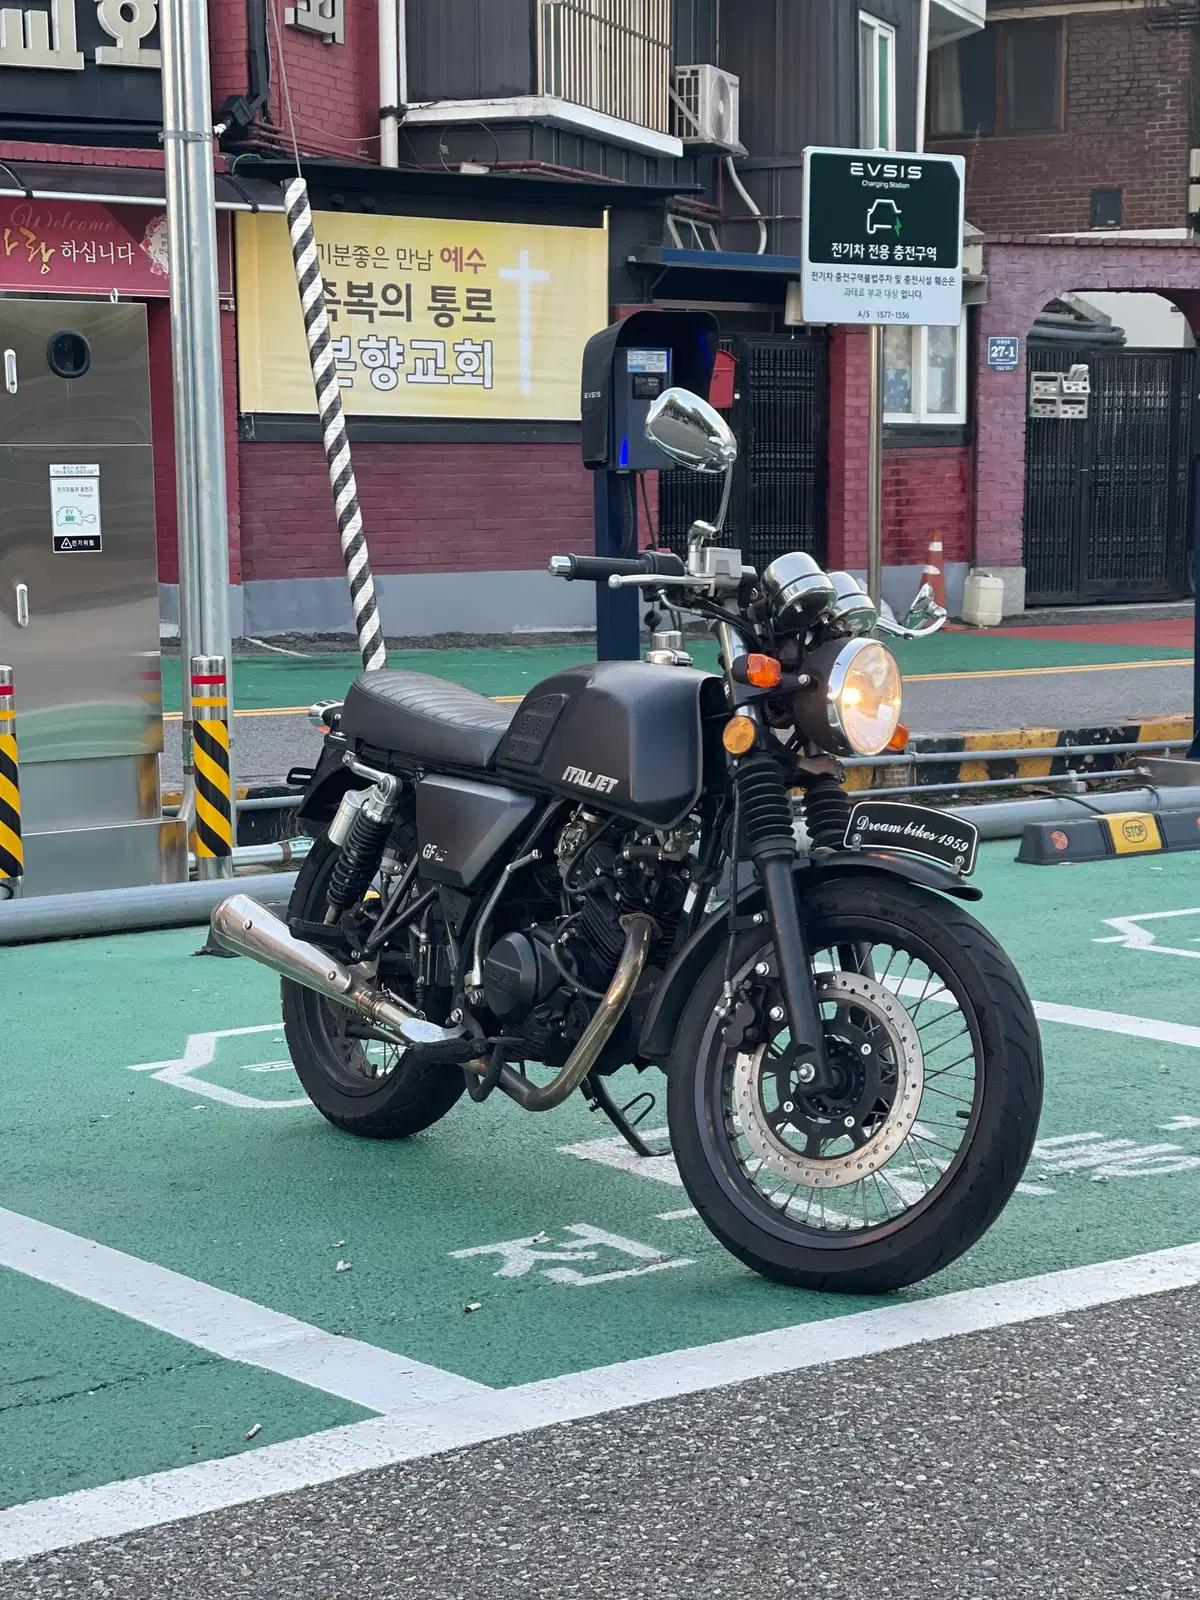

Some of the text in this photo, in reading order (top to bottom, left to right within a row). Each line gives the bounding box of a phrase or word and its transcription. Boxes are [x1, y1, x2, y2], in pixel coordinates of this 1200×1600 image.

[850, 162, 922, 179] EVSIS
[861, 179, 910, 189] Charging Station
[10, 203, 114, 233] Welcome
[60, 239, 136, 265] 하십니다
[315, 243, 487, 274] 기분좋은 만남 예수
[831, 242, 937, 262] 전기차 전용 충전구역
[811, 271, 833, 282] 전기차
[895, 275, 902, 285] 및
[903, 275, 932, 286] 충전시설
[844, 287, 922, 300] 과태료 부과 대상 입니다
[427, 284, 496, 328] 통로
[857, 310, 910, 320] A/S 1577-1556
[990, 345, 1015, 358] 27-1
[561, 765, 619, 794] ITALJET
[856, 815, 969, 852] Dream bikes 1959
